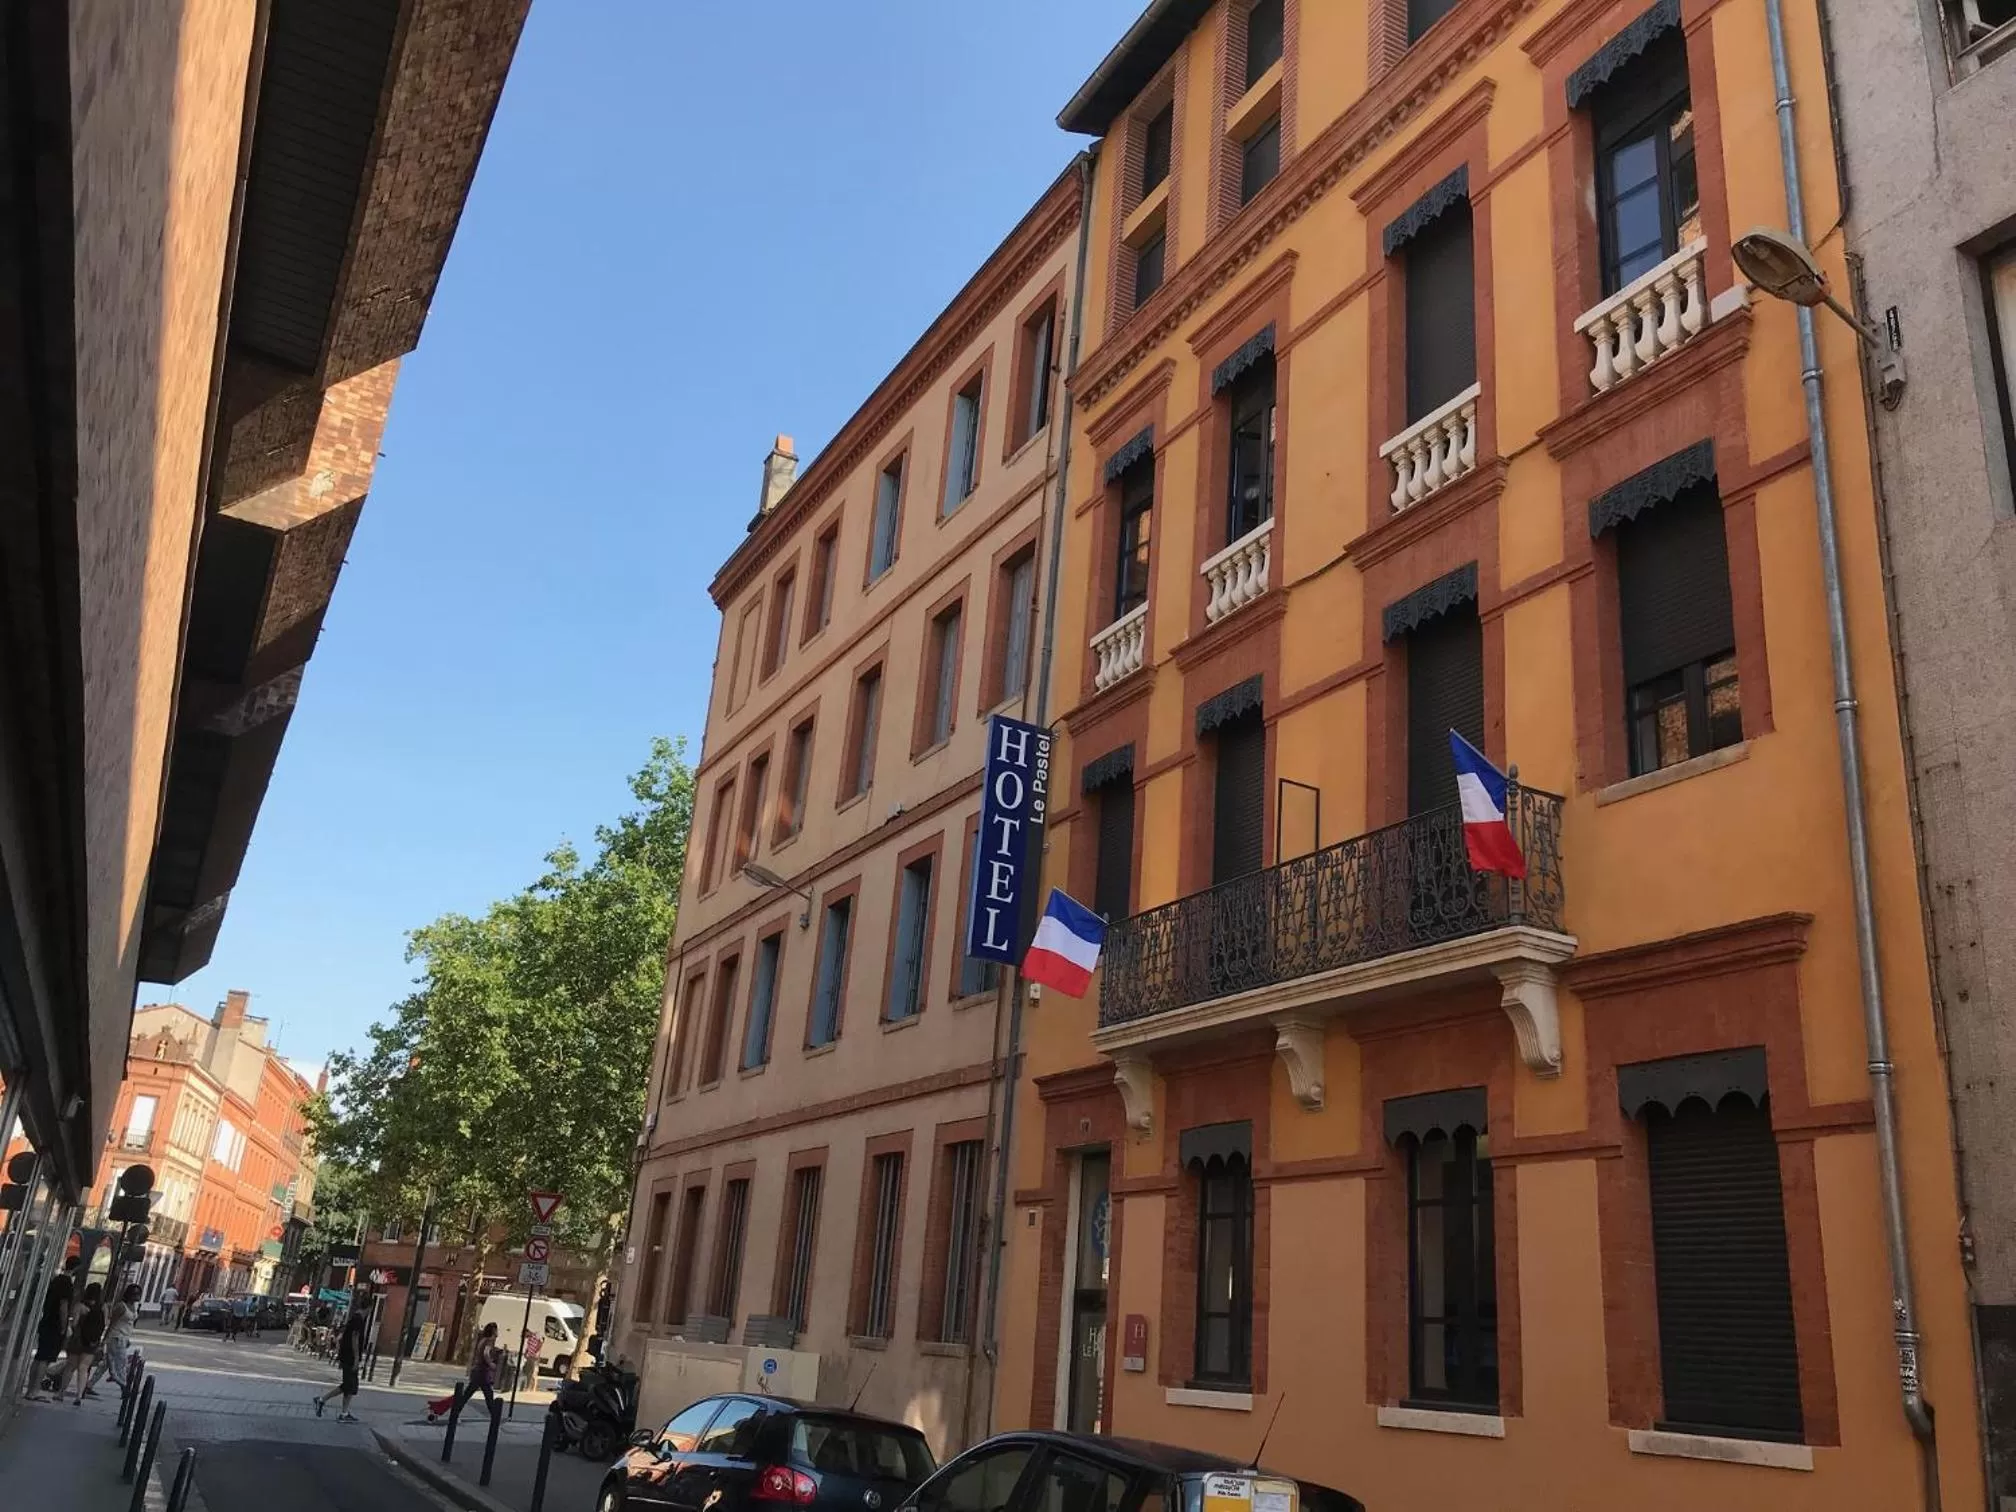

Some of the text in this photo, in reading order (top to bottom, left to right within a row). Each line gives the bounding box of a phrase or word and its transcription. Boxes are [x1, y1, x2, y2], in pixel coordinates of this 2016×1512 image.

[982, 724, 1030, 951] HOTEL
[1030, 733, 1051, 825] Le Pastel
